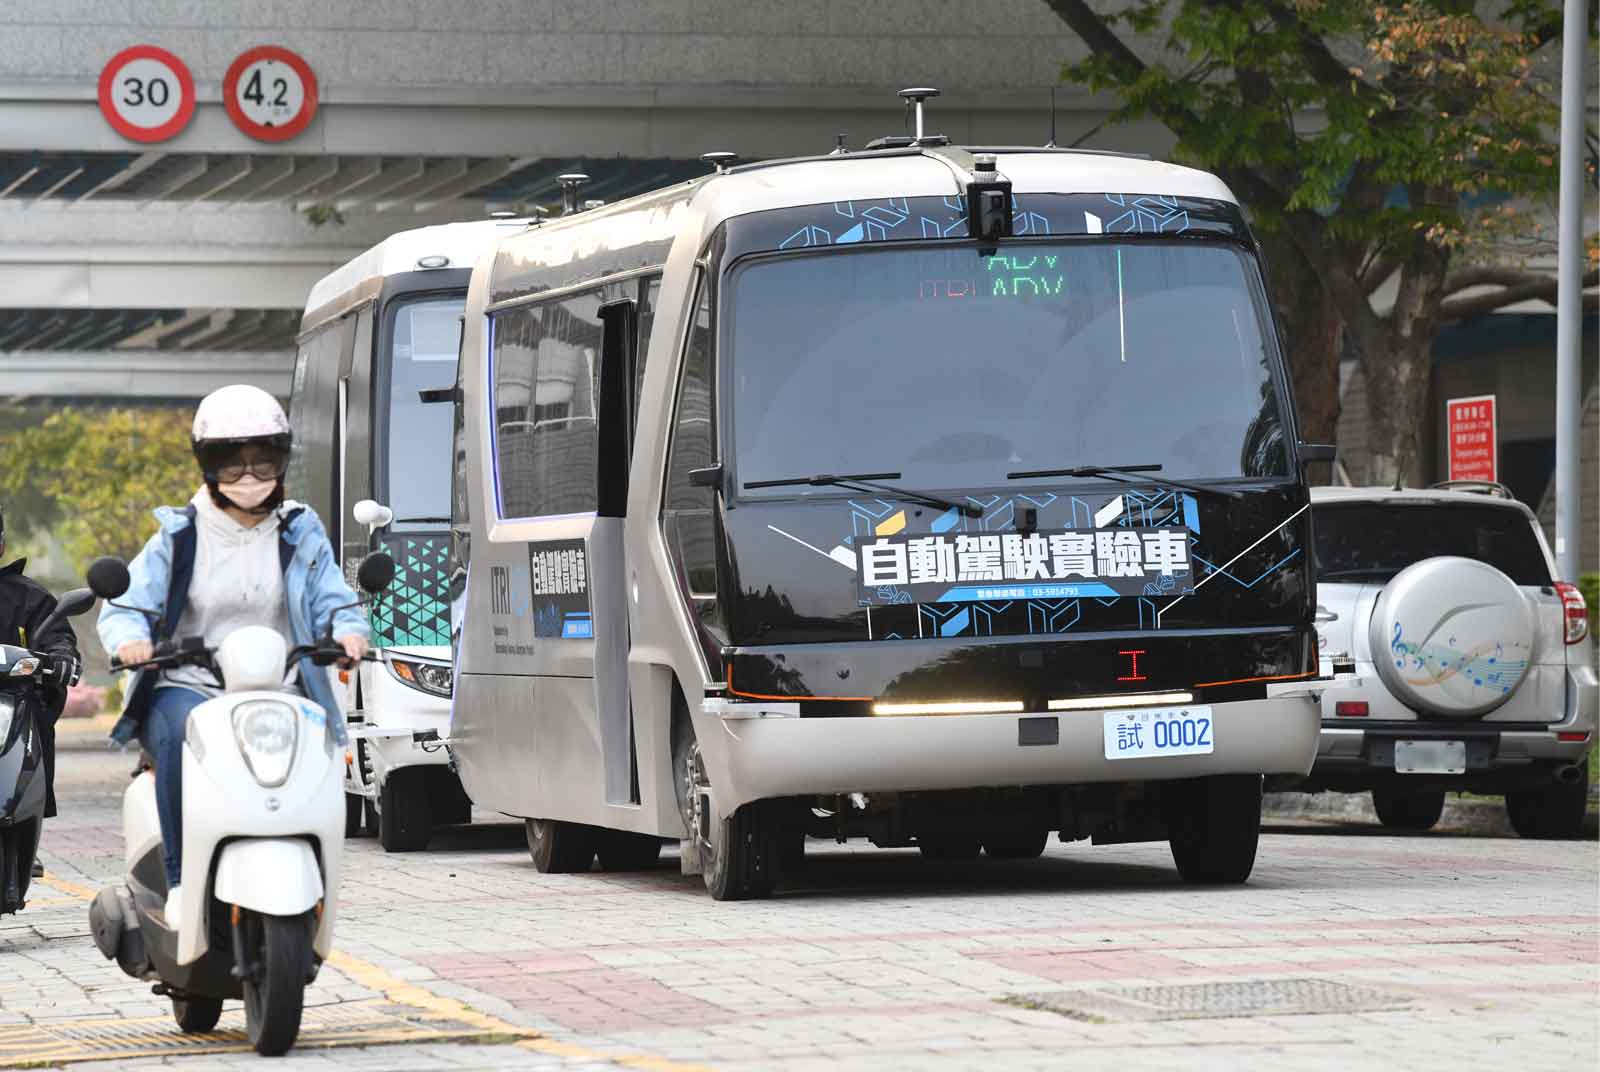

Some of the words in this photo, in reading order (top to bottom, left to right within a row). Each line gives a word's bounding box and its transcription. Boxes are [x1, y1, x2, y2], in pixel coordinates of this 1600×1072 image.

[123, 78, 168, 106] 30
[243, 69, 288, 106] 4.2
[861, 529, 1190, 586] 自動駕駛實驗車
[491, 566, 511, 615] ITRI
[1116, 722, 1144, 750] 試
[1154, 718, 1211, 748] 0002
